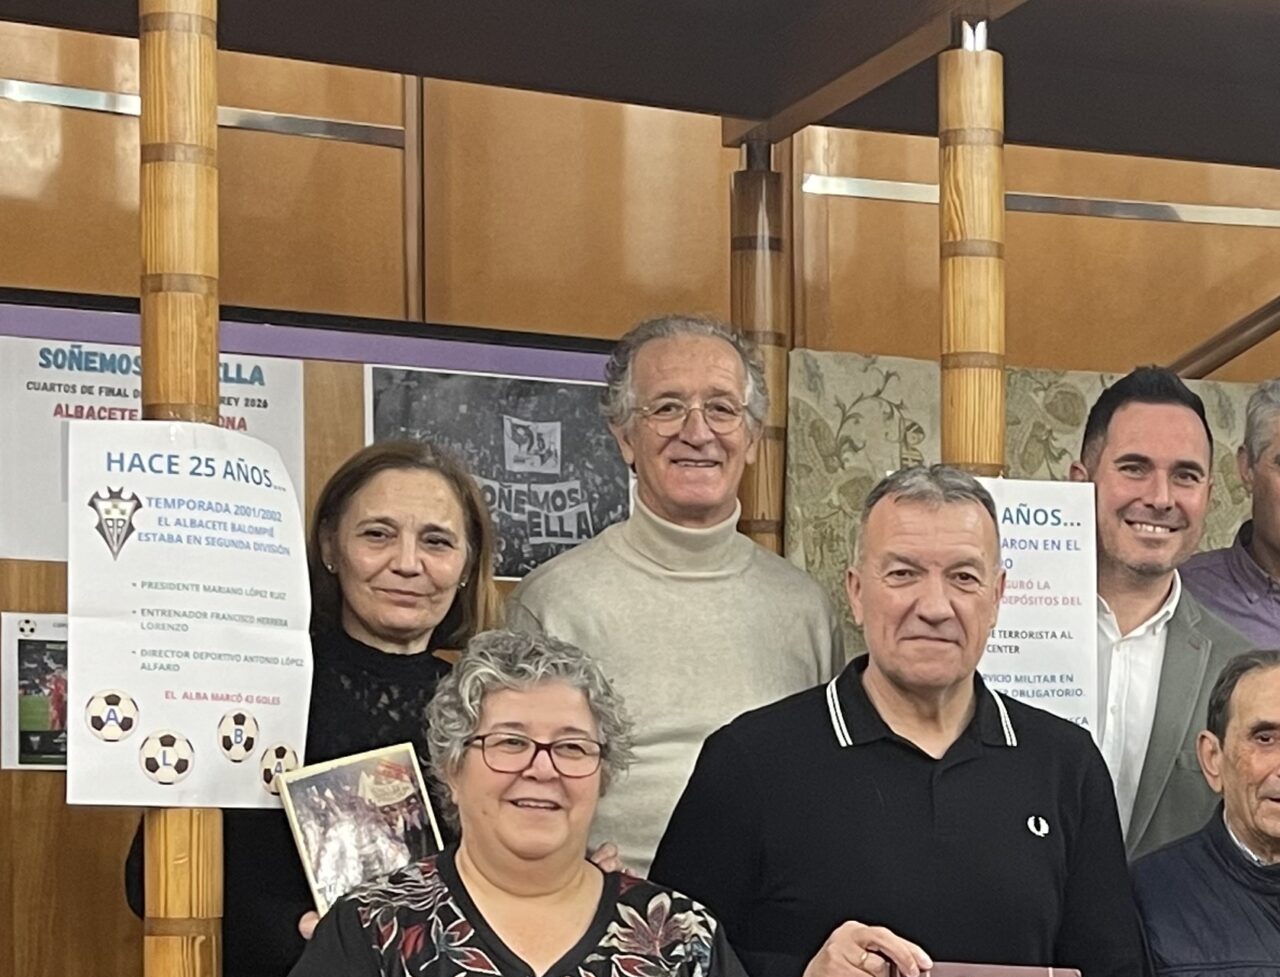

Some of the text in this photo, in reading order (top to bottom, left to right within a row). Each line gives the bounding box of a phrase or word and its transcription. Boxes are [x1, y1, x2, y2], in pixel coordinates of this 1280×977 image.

[219, 362, 265, 386] LLA
[26, 381, 77, 394] CUARTOS
[81, 385, 94, 395] DE
[98, 386, 129, 398] FINAL
[133, 388, 141, 399] D
[53, 403, 139, 421] ALBACETE
[107, 451, 180, 475] HACE
[189, 455, 216, 477] 25
[481, 481, 581, 514] OÑEMOS
[146, 496, 282, 522] TEMPORADA 2001/2002
[1002, 503, 1081, 526] AÑOS...
[158, 516, 170, 527] EL
[174, 518, 228, 532] ALBACETE
[528, 510, 592, 539] ELLA
[137, 532, 290, 556] ESTABA EN SEGUNDA DIVISIÓN
[1002, 538, 1080, 551] ARON EN EL
[141, 580, 200, 592] PRESIDENTE
[203, 584, 243, 596] MARIANO
[1037, 581, 1050, 590] LA
[1002, 594, 1081, 606] DEPÓSITOS DEL
[141, 608, 208, 620] ENTRENADOR
[210, 611, 255, 624] FRANCISCO
[141, 622, 189, 632] LORENZO
[998, 630, 1057, 639] TERRORISTA
[1061, 631, 1073, 639] AL
[987, 644, 1020, 654] CENTER
[140, 649, 190, 659] DIRECTOR
[193, 651, 241, 663] DEPORTIVO
[243, 655, 279, 666] ANTONIO
[140, 662, 181, 672] ALFARO
[1014, 675, 1056, 684] MILITAR
[1060, 674, 1074, 683] EN
[165, 690, 176, 700] EL
[182, 692, 209, 702] ALBA
[211, 692, 242, 704] MARCÓ
[255, 695, 281, 706] GOLES
[105, 708, 120, 725] A
[234, 728, 243, 745] B
[162, 750, 171, 766] L
